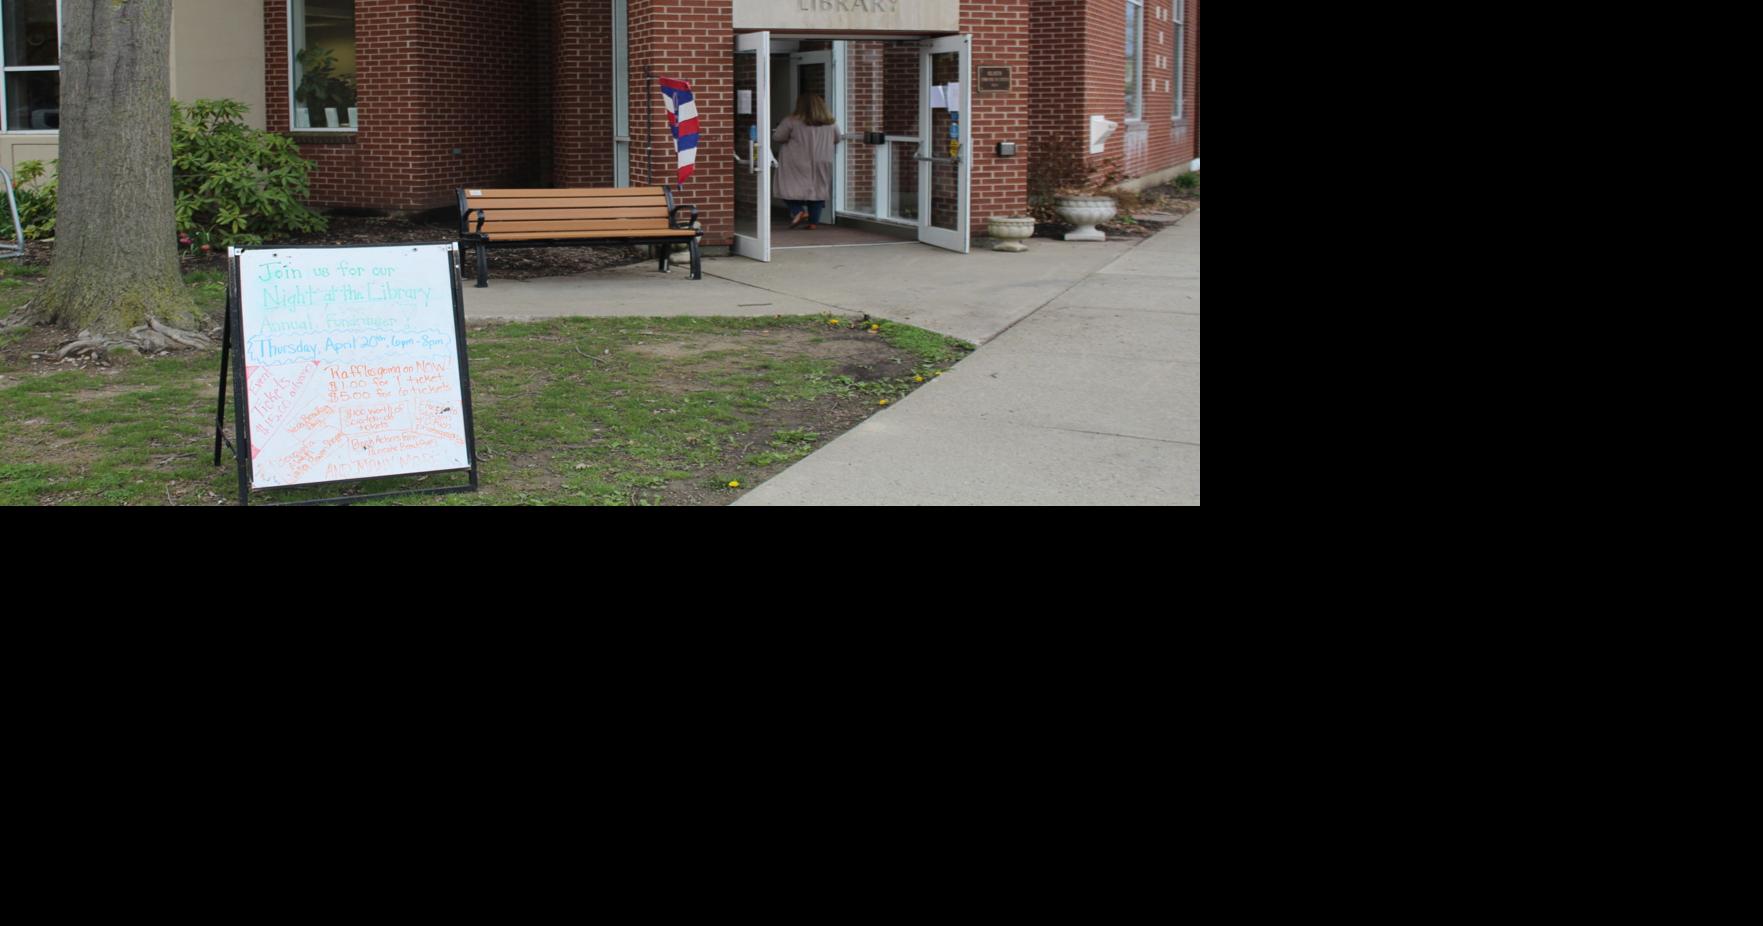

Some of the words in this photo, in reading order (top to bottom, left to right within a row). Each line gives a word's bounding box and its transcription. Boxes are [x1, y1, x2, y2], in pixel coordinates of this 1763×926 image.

[797, 0, 897, 12] LIBRARY
[258, 261, 302, 282] Join
[313, 266, 329, 277] us
[337, 260, 366, 277] for
[372, 265, 397, 277] our
[263, 285, 318, 312] Night
[323, 287, 338, 304] at
[340, 284, 364, 301] the
[367, 281, 431, 307] Library
[260, 314, 314, 333] Annual
[325, 336, 357, 354] April
[403, 366, 414, 374] on
[408, 374, 443, 384] ticket
[328, 391, 371, 403] $5.00
